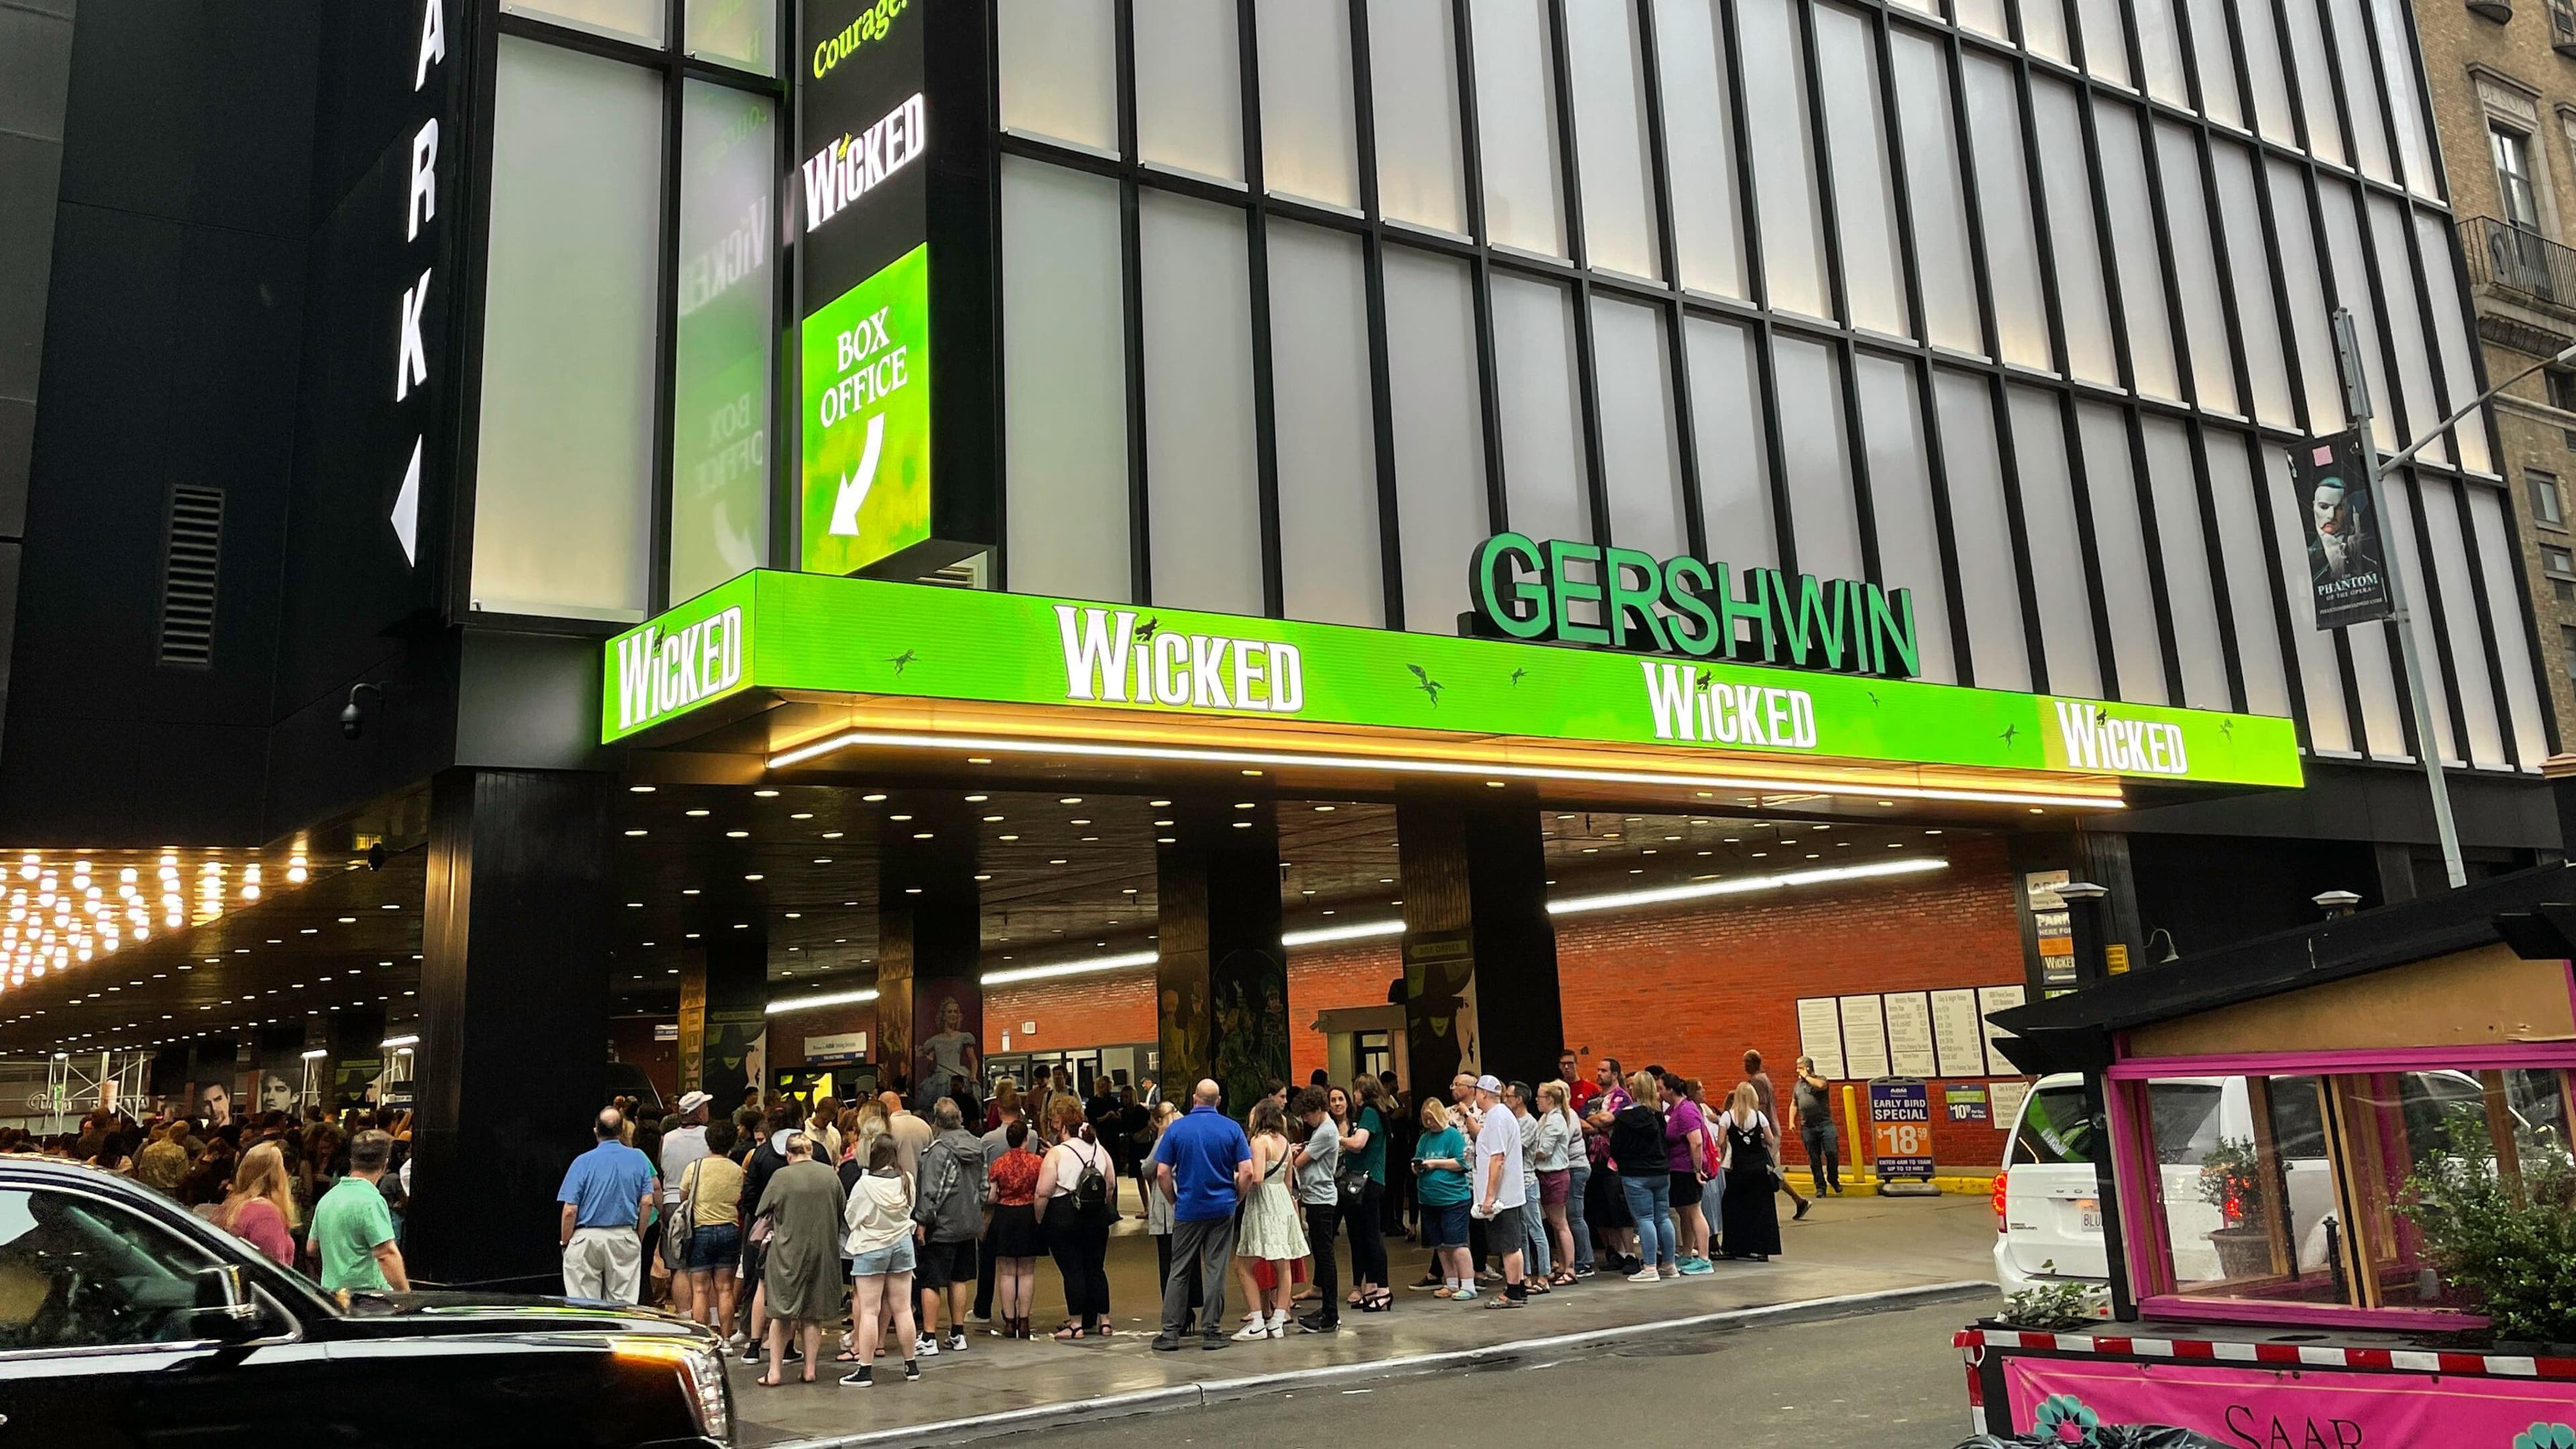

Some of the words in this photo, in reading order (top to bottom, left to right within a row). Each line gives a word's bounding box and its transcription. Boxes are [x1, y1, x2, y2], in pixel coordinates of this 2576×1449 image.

[2480, 82, 2498, 103] DE
[2499, 89, 2534, 119] SOTO
[837, 307, 890, 374] BOX
[820, 352, 908, 428] OFFICE
[2318, 573, 2378, 596] PHANTOM
[1473, 531, 1921, 678] GERSHWIN
[1874, 1099, 1900, 1108] EARLY
[1904, 1099, 1926, 1108] BIRD
[1875, 1109, 1927, 1120] SPECIAL
[2083, 1213, 2102, 1227] 8LU
[2225, 1405, 2363, 1449] SAAR
